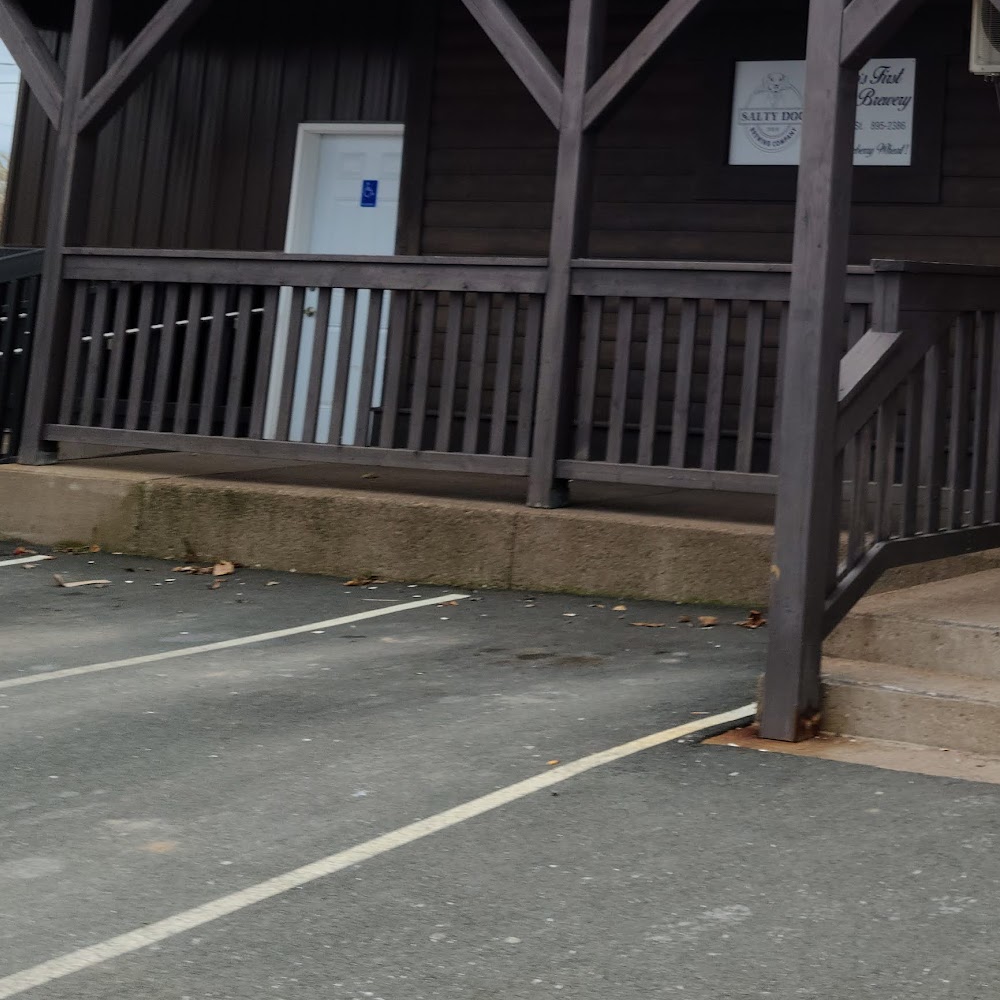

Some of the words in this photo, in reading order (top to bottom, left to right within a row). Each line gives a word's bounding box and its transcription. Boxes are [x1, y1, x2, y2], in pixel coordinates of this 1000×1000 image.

[869, 66, 905, 85] First
[857, 87, 912, 112] Brewery
[741, 111, 778, 121] SALTY
